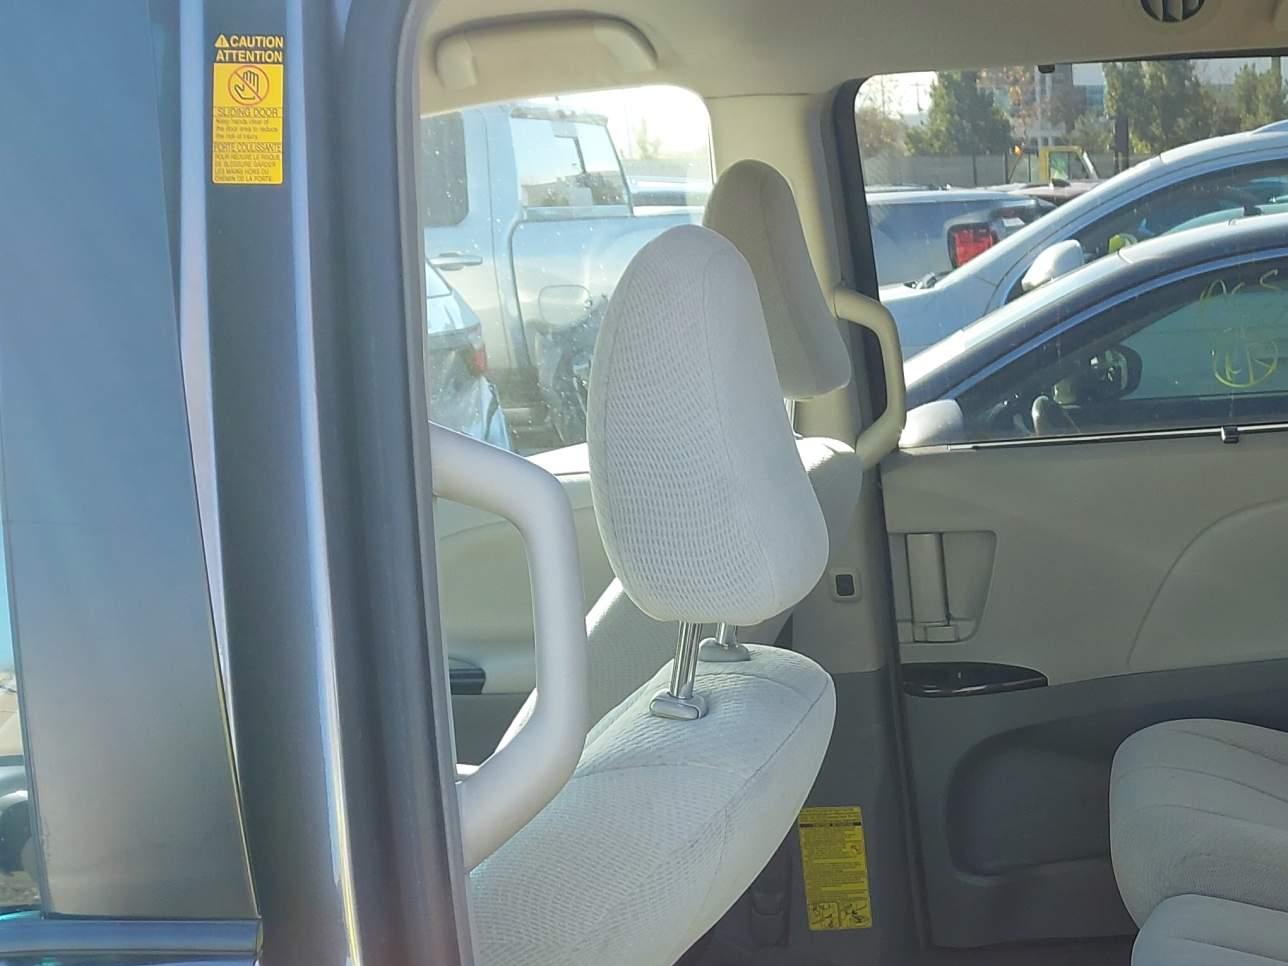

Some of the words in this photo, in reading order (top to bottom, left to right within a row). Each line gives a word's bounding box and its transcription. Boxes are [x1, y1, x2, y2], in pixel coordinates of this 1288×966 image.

[230, 35, 284, 48] CAUTION
[216, 50, 283, 62] ATTENTION
[217, 107, 251, 118] SLIDING
[253, 107, 278, 118] DOOR
